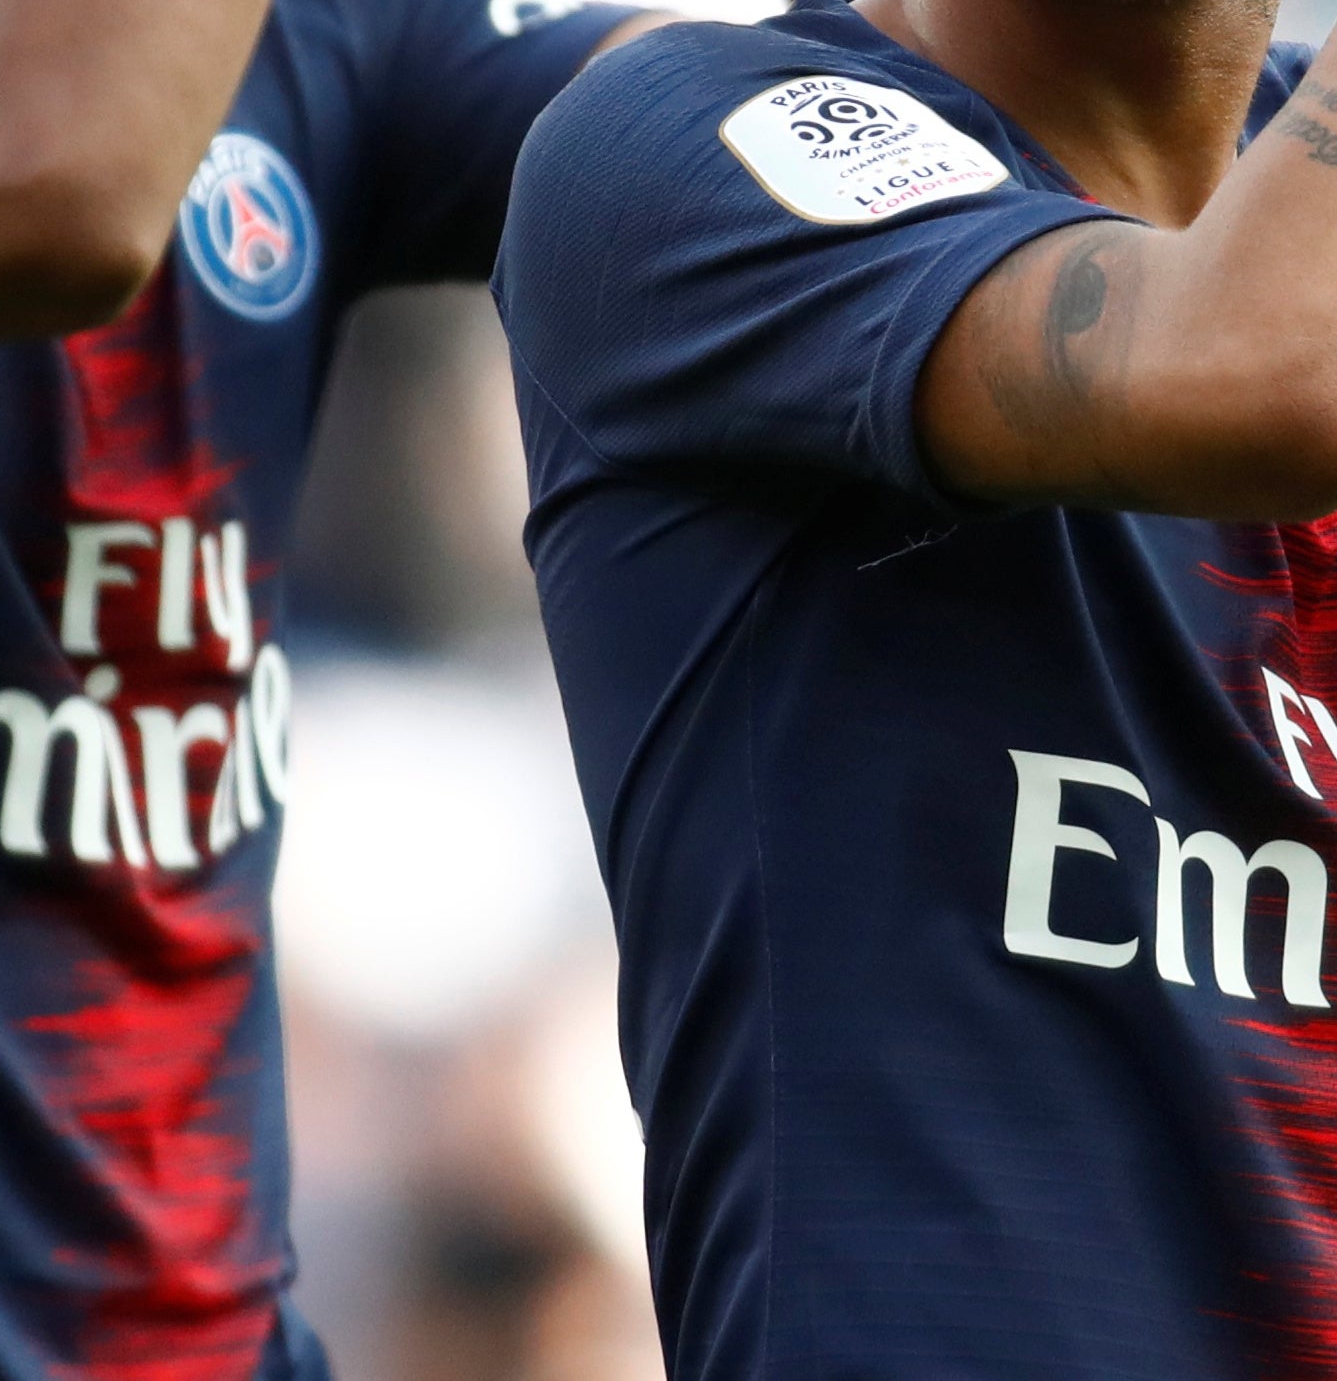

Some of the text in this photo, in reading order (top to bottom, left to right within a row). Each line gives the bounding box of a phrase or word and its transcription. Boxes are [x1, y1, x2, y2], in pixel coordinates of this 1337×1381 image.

[769, 81, 847, 107] PARIS
[839, 146, 912, 179] CHAMPION
[854, 161, 955, 206] LIGUE
[869, 170, 994, 215] Conforama
[60, 516, 253, 672] Fly
